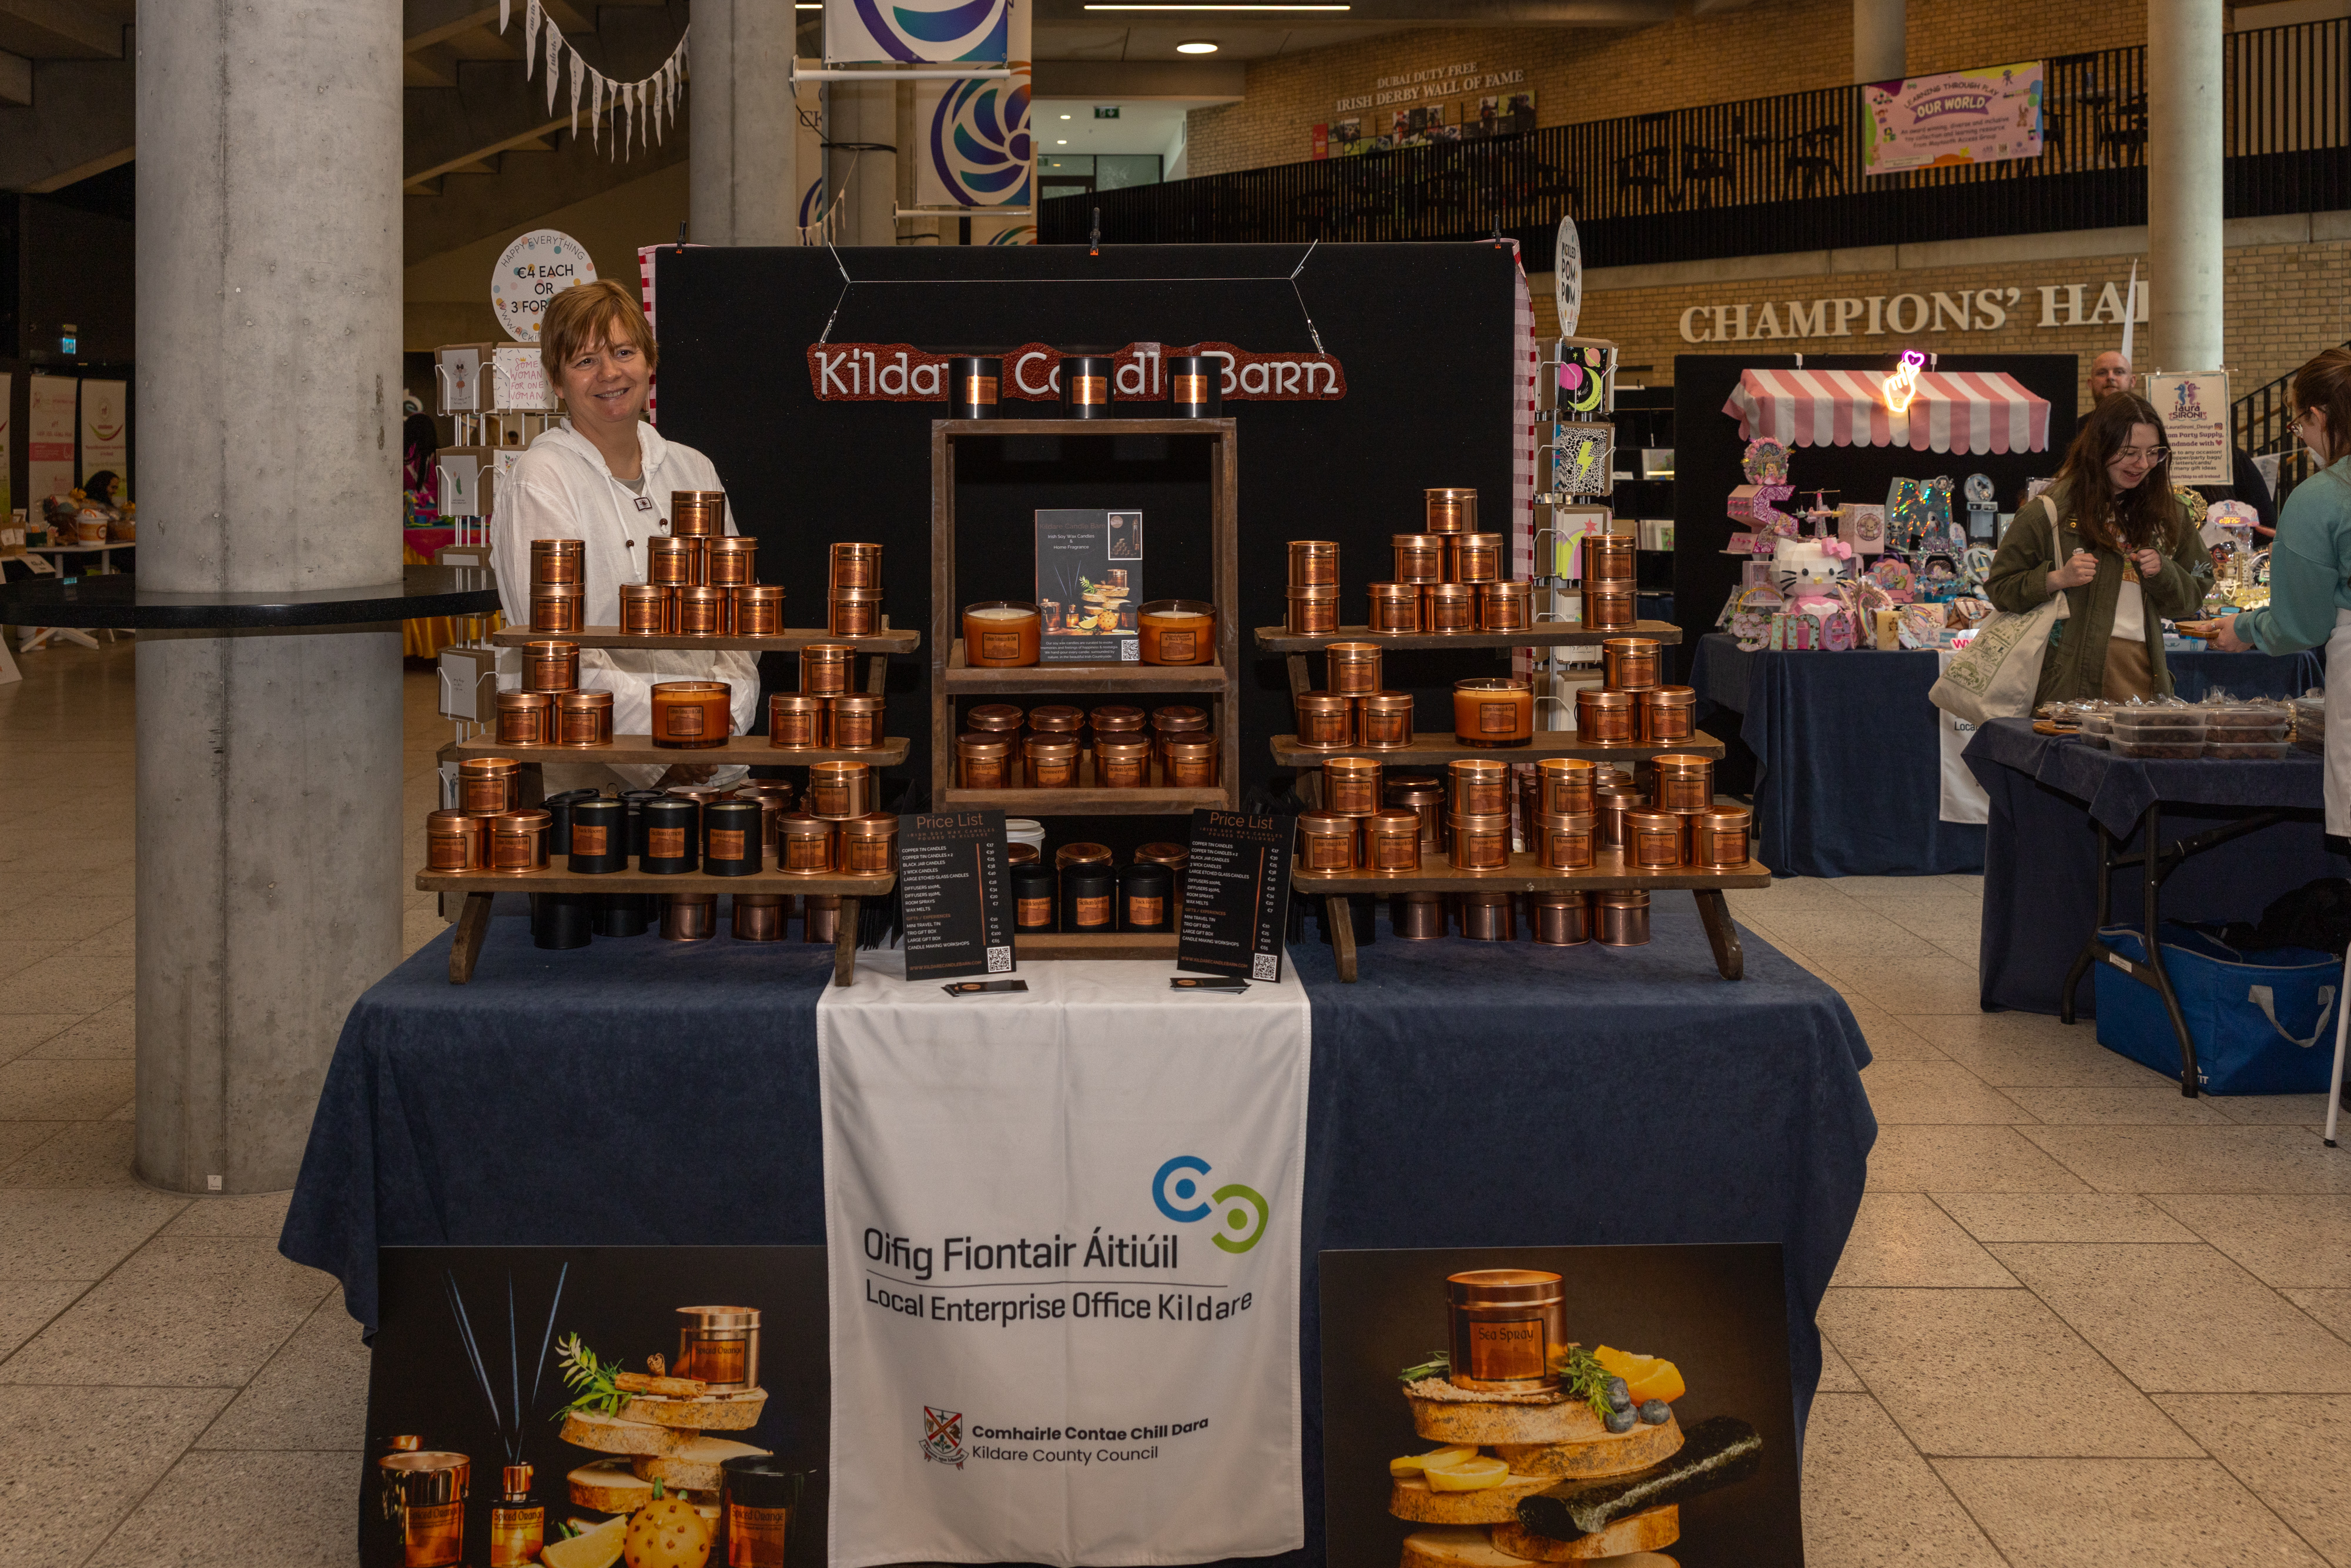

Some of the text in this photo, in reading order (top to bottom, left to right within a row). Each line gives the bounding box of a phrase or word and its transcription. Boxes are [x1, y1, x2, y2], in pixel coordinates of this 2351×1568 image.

[1377, 62, 1478, 89] DUBAI DUTY FREE
[1337, 69, 1524, 112] IRISH DERBY WALL OF FAME
[1904, 82, 1999, 109] LEARNING THROUGH PLAY
[1917, 96, 1986, 118] OUR WORLD
[501, 236, 585, 267] HAPPY EVERYTHING
[1562, 242, 1576, 259] PICKLED
[517, 264, 574, 279] €4 EACH
[1562, 258, 1575, 283] POM
[535, 283, 554, 294] OR
[1561, 282, 1575, 306] POM
[511, 300, 547, 313] 3 FOR
[515, 358, 538, 371] SOME
[815, 347, 949, 396] Kilda
[1201, 351, 1338, 396] Barn
[510, 368, 542, 381] WOMAN
[917, 813, 983, 829] Price List
[1210, 812, 1273, 830] Price List
[909, 960, 982, 970] WWW.KILDARECANDLEBARN.COM
[863, 1226, 1178, 1280] Oifig Fiontair Áitiúil
[866, 1279, 1252, 1328] Local Enterprise Office Kildare
[1478, 1327, 1534, 1343] Sea Spray
[695, 1346, 743, 1355] Spiced Orange
[972, 1418, 1209, 1440] Comhairle Contae Chill Dara
[972, 1446, 1028, 1460] Kildare
[1033, 1449, 1092, 1466] County
[1096, 1446, 1158, 1462] Council
[408, 1507, 459, 1521] Spiced Orange
[494, 1510, 543, 1522] Spiced Orange
[732, 1507, 783, 1522] Spiced Orange
